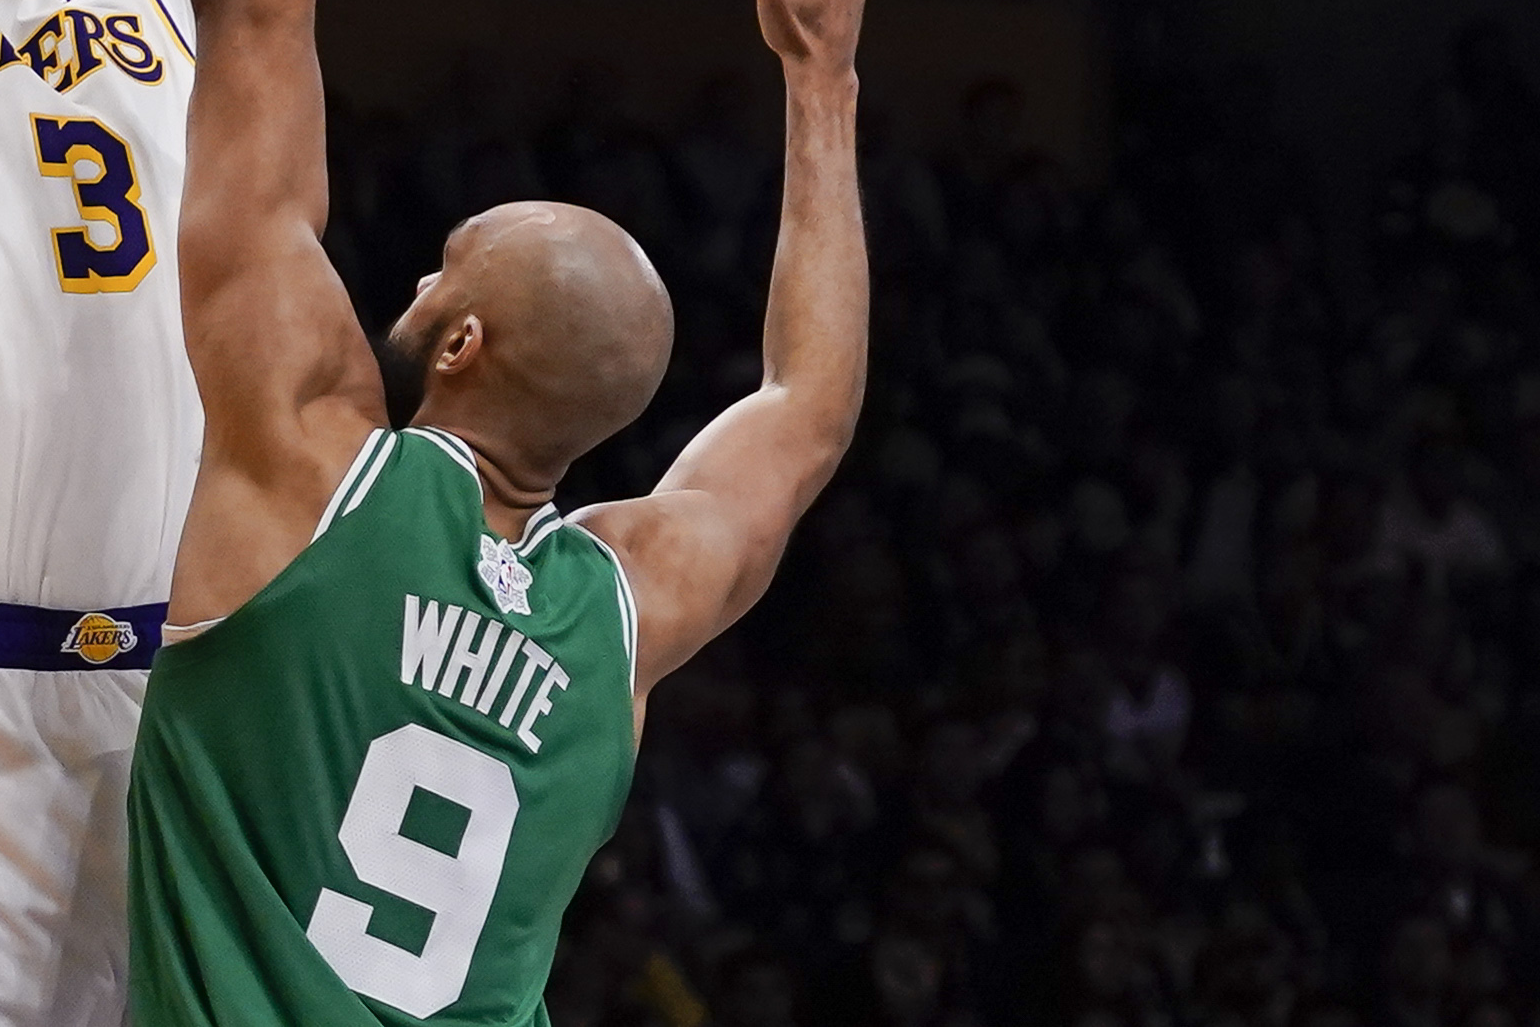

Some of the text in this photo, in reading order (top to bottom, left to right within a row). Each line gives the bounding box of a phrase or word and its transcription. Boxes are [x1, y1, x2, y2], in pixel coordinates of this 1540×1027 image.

[29, 111, 158, 295] 3
[65, 626, 137, 651] LAKERS
[400, 593, 571, 755] WHITE
[305, 722, 520, 1021] 9
